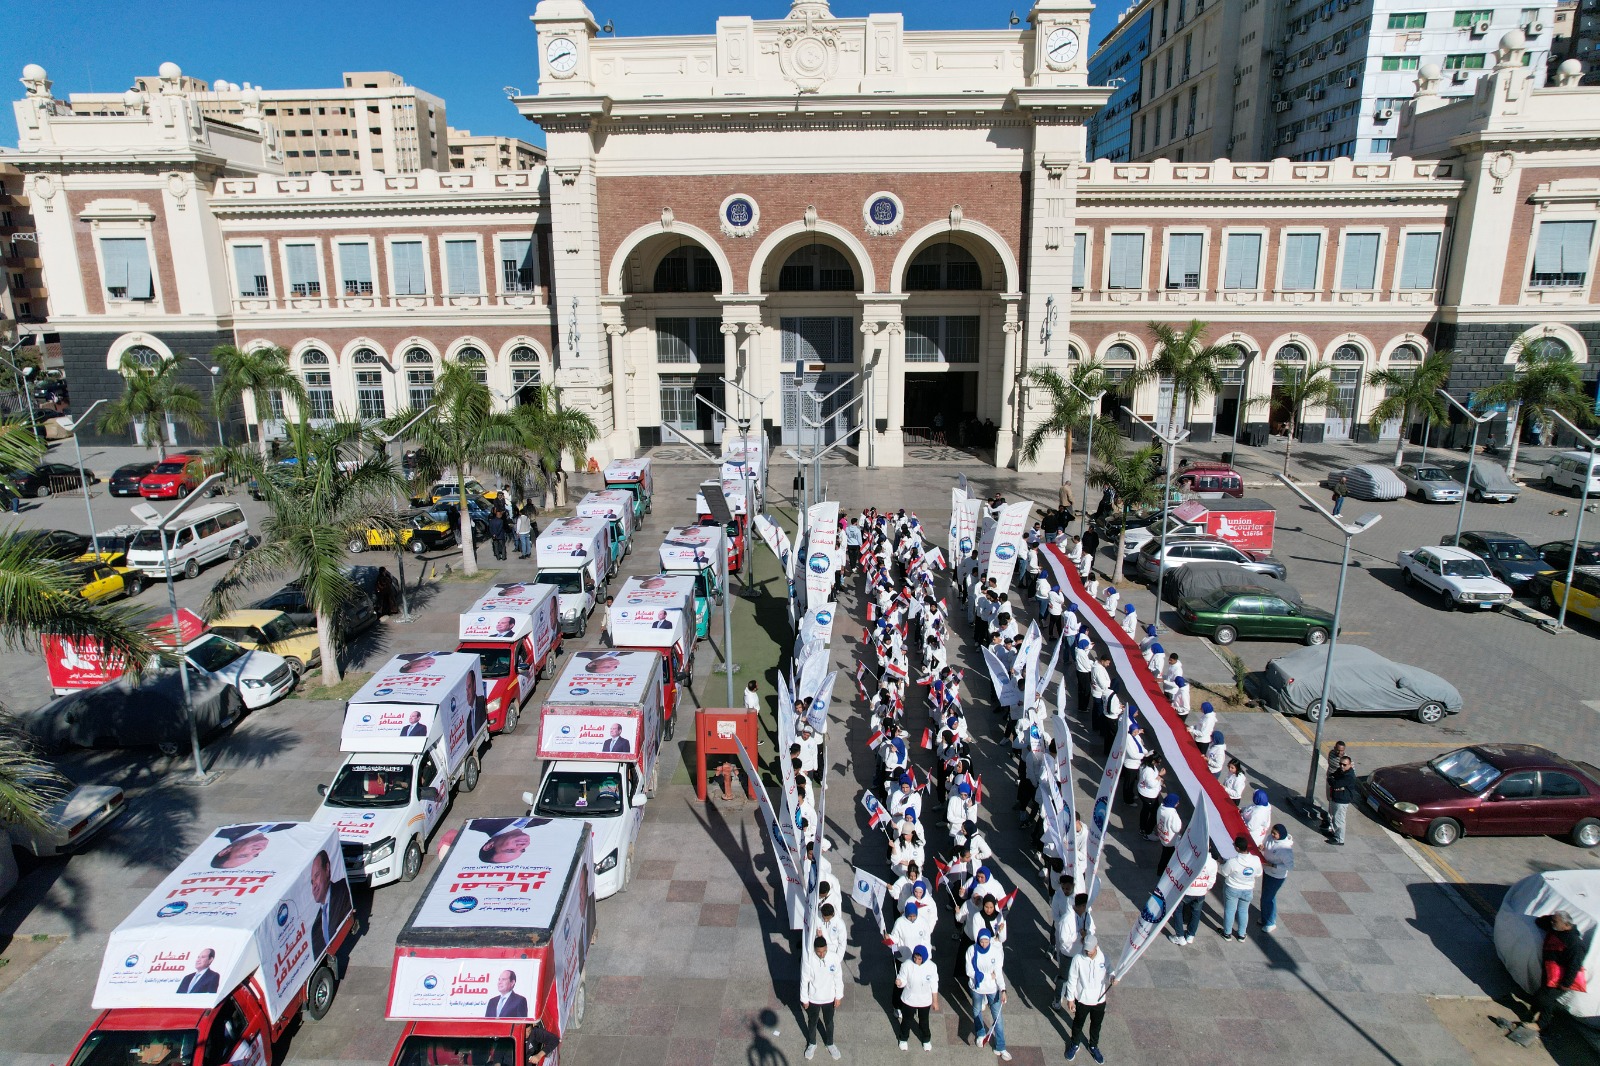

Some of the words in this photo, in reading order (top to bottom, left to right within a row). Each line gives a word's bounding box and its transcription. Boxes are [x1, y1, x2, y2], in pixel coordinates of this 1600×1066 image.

[378, 718, 403, 726] مسافر
[180, 875, 274, 885] مسافر
[457, 871, 550, 881] مسافر
[166, 885, 264, 898] افطار
[449, 881, 546, 893] افطار
[274, 922, 306, 977] افطار
[152, 951, 190, 963] افطار
[148, 962, 185, 974] مسافر
[276, 940, 308, 992] مسافر
[452, 972, 490, 985] افطار
[450, 984, 488, 996] مسافر
